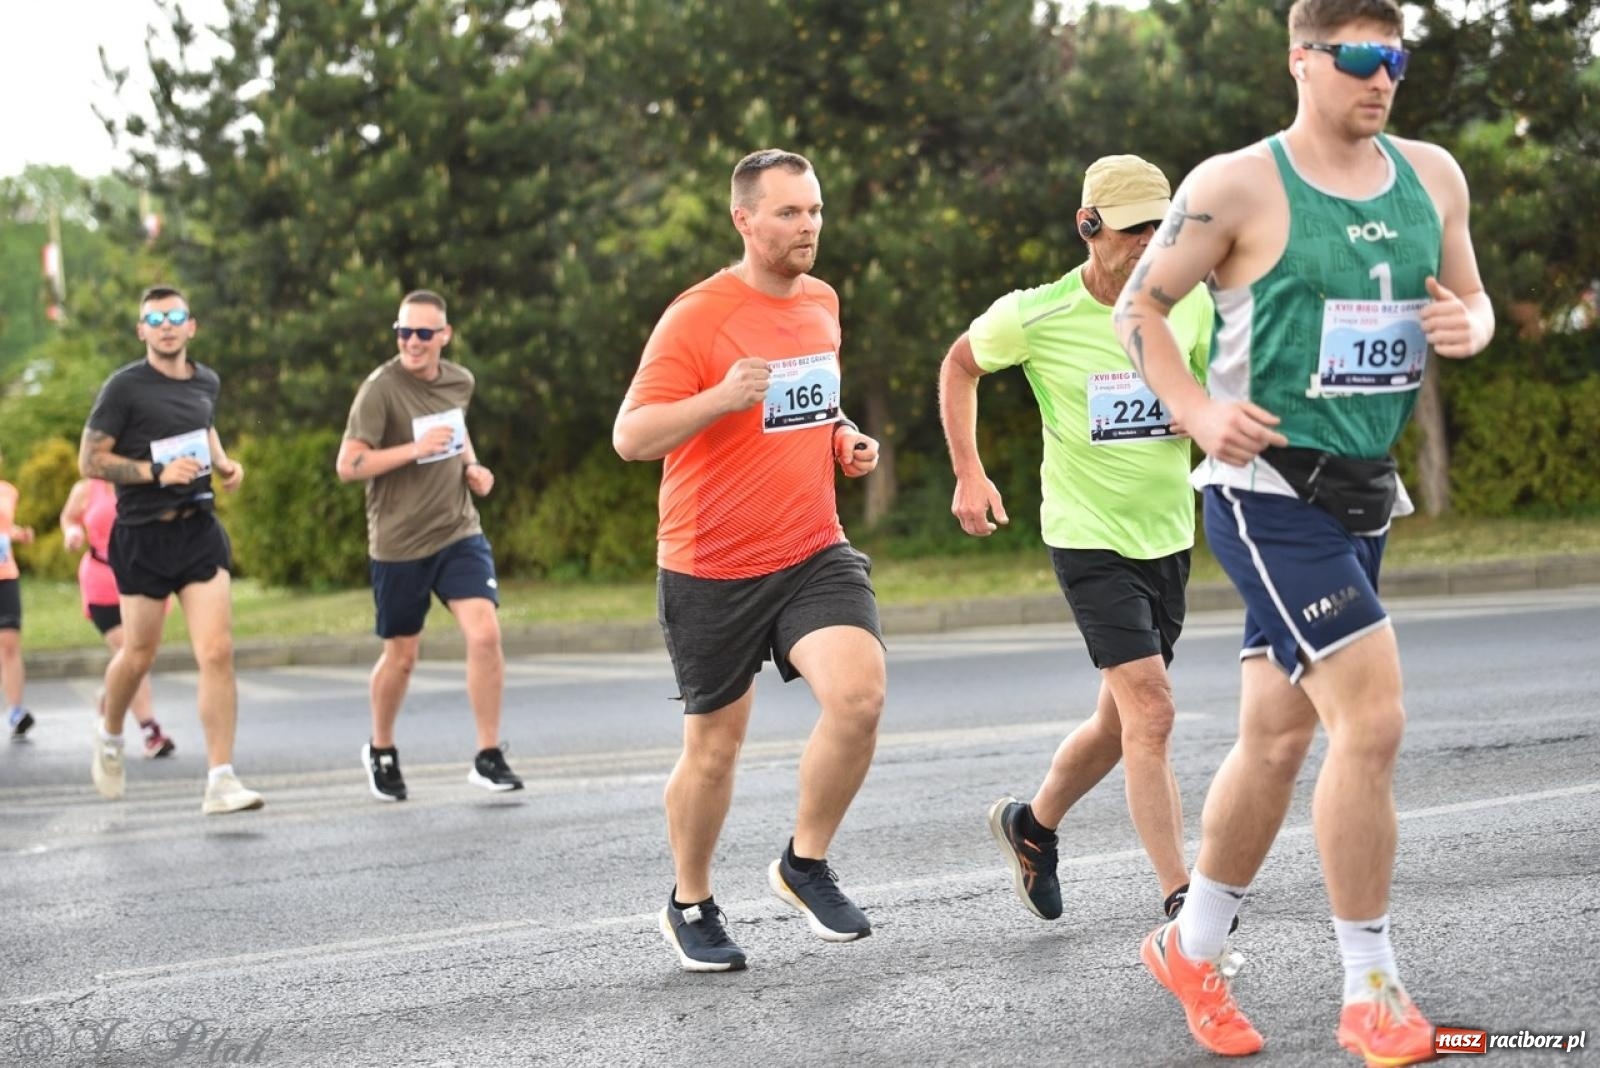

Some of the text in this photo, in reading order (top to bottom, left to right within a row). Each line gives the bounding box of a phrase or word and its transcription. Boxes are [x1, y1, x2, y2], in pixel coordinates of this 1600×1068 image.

[1346, 220, 1398, 244] POL
[1368, 261, 1393, 301] 1
[1352, 338, 1408, 368] 189
[785, 383, 823, 410] 166
[1113, 398, 1164, 424] 224
